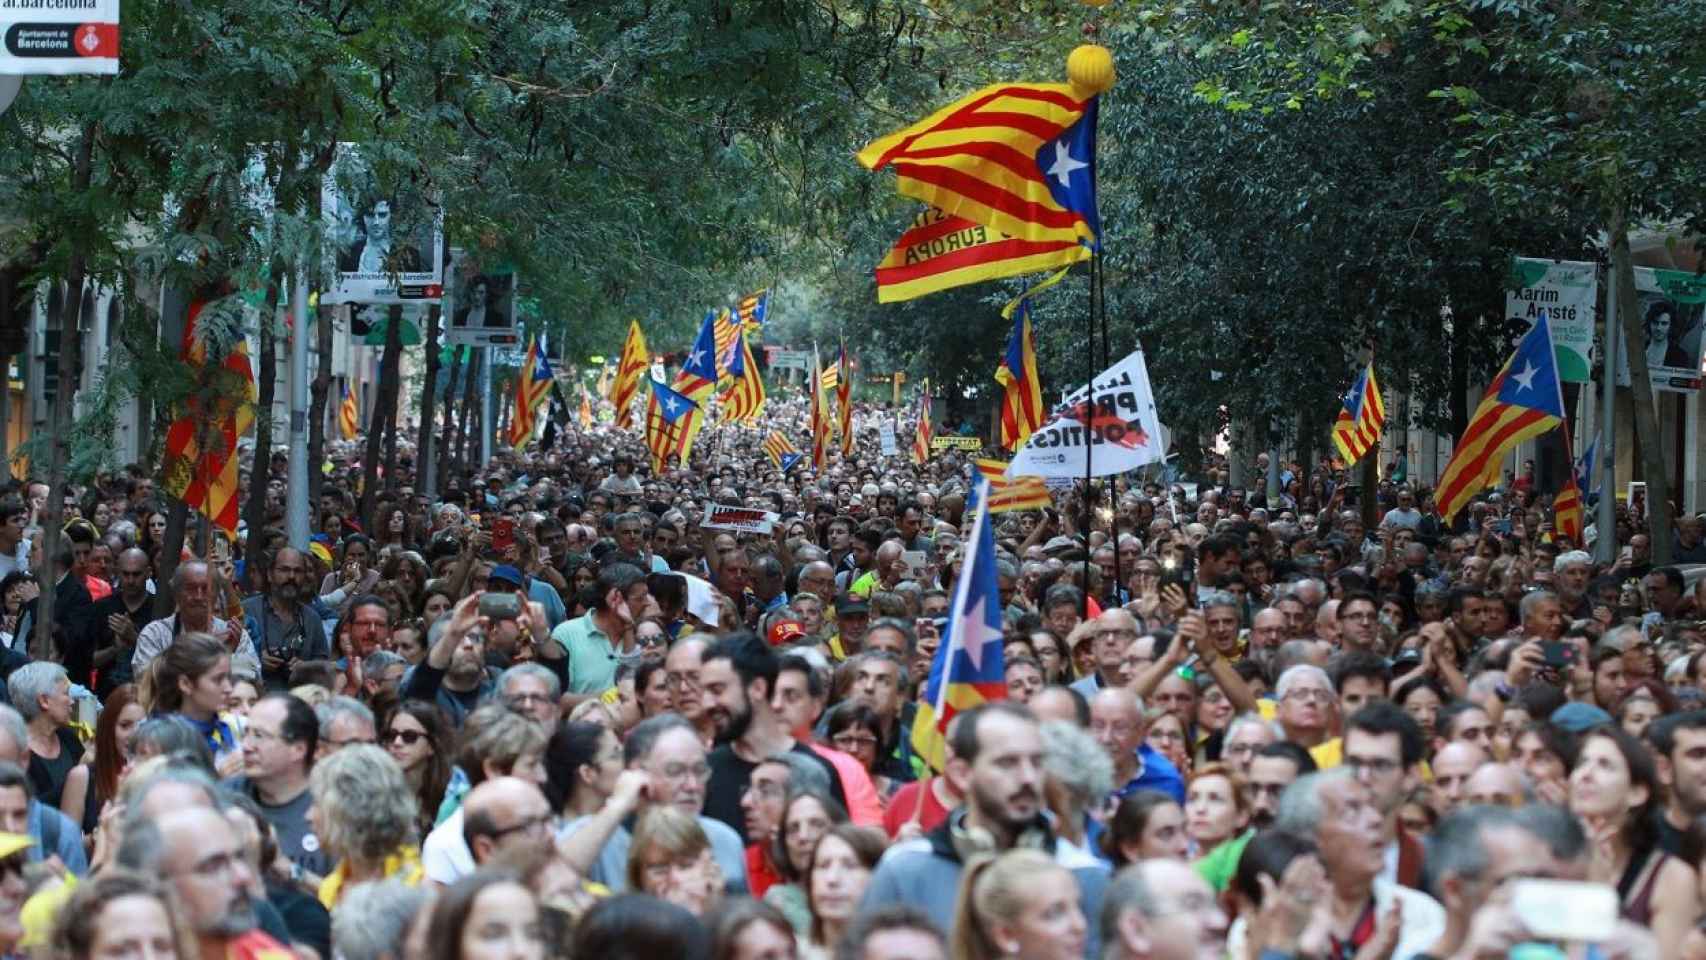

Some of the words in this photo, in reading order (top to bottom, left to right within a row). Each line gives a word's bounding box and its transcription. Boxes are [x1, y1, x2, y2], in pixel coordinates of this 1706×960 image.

[18, 29, 57, 39] Ajuntament
[59, 30, 69, 38] de
[17, 38, 69, 49] Barcelona
